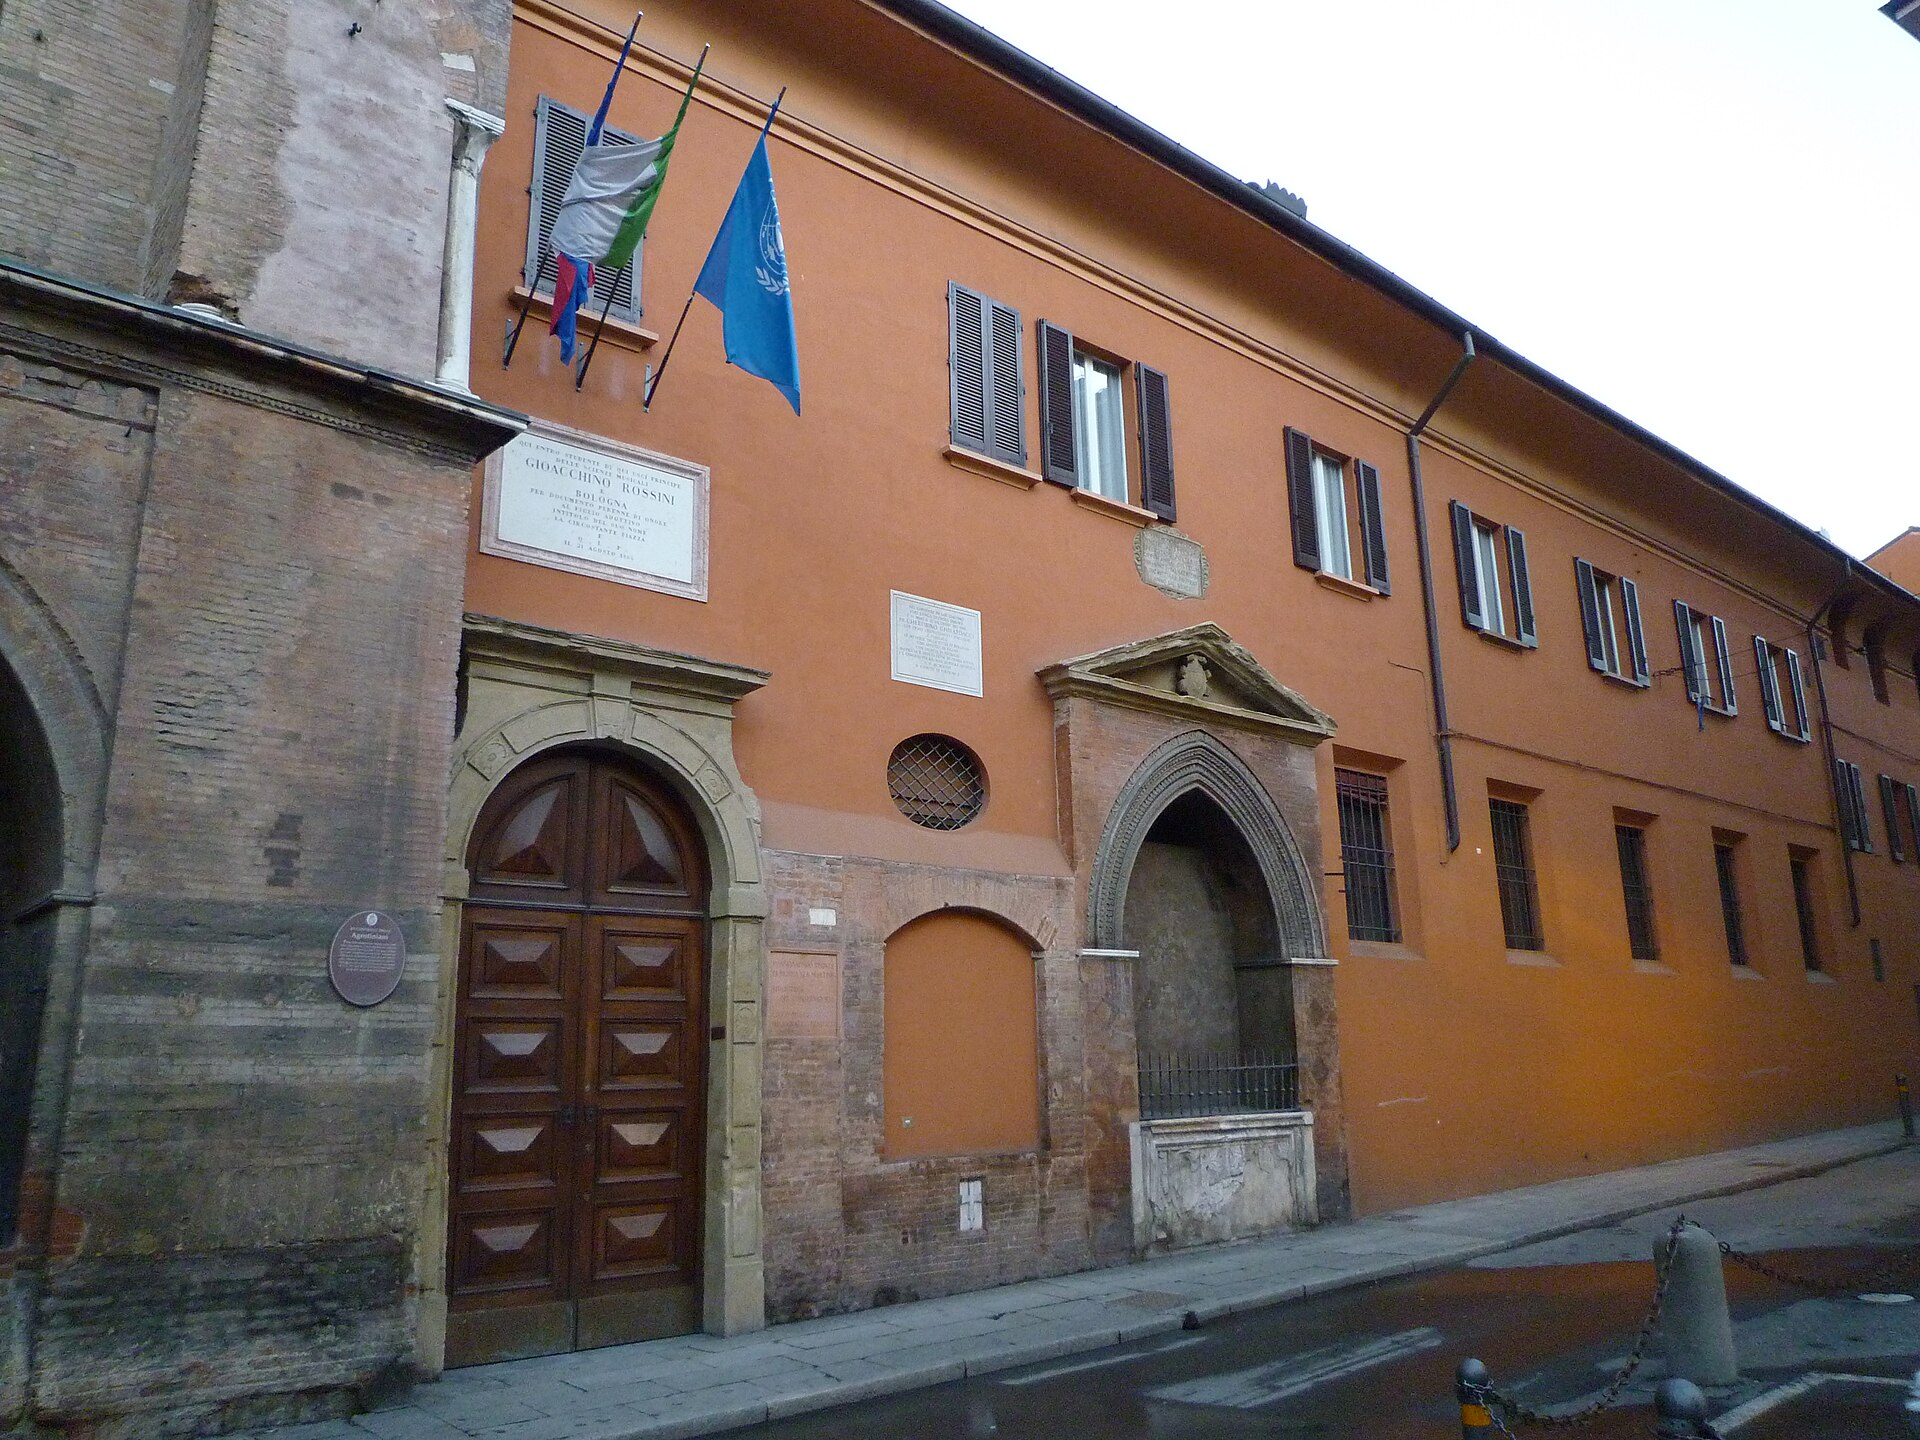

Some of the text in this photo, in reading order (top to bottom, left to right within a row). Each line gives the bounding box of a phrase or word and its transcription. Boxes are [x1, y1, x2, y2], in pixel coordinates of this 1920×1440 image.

[519, 440, 531, 449] QUI
[555, 457, 578, 468] DELLE
[525, 457, 675, 506] GIOACCHINO ROSSINI
[530, 487, 543, 495] PER
[548, 492, 594, 508] DOCUMENTO
[598, 504, 629, 517] PERENNE
[575, 489, 627, 510] BOLOGNA
[605, 513, 640, 526] ADOTTIVO
[568, 519, 616, 535] CIRCOSTANTE
[621, 532, 645, 542] PIAZZA
[628, 526, 646, 535] NOME
[588, 545, 615, 556] AGOSTO
